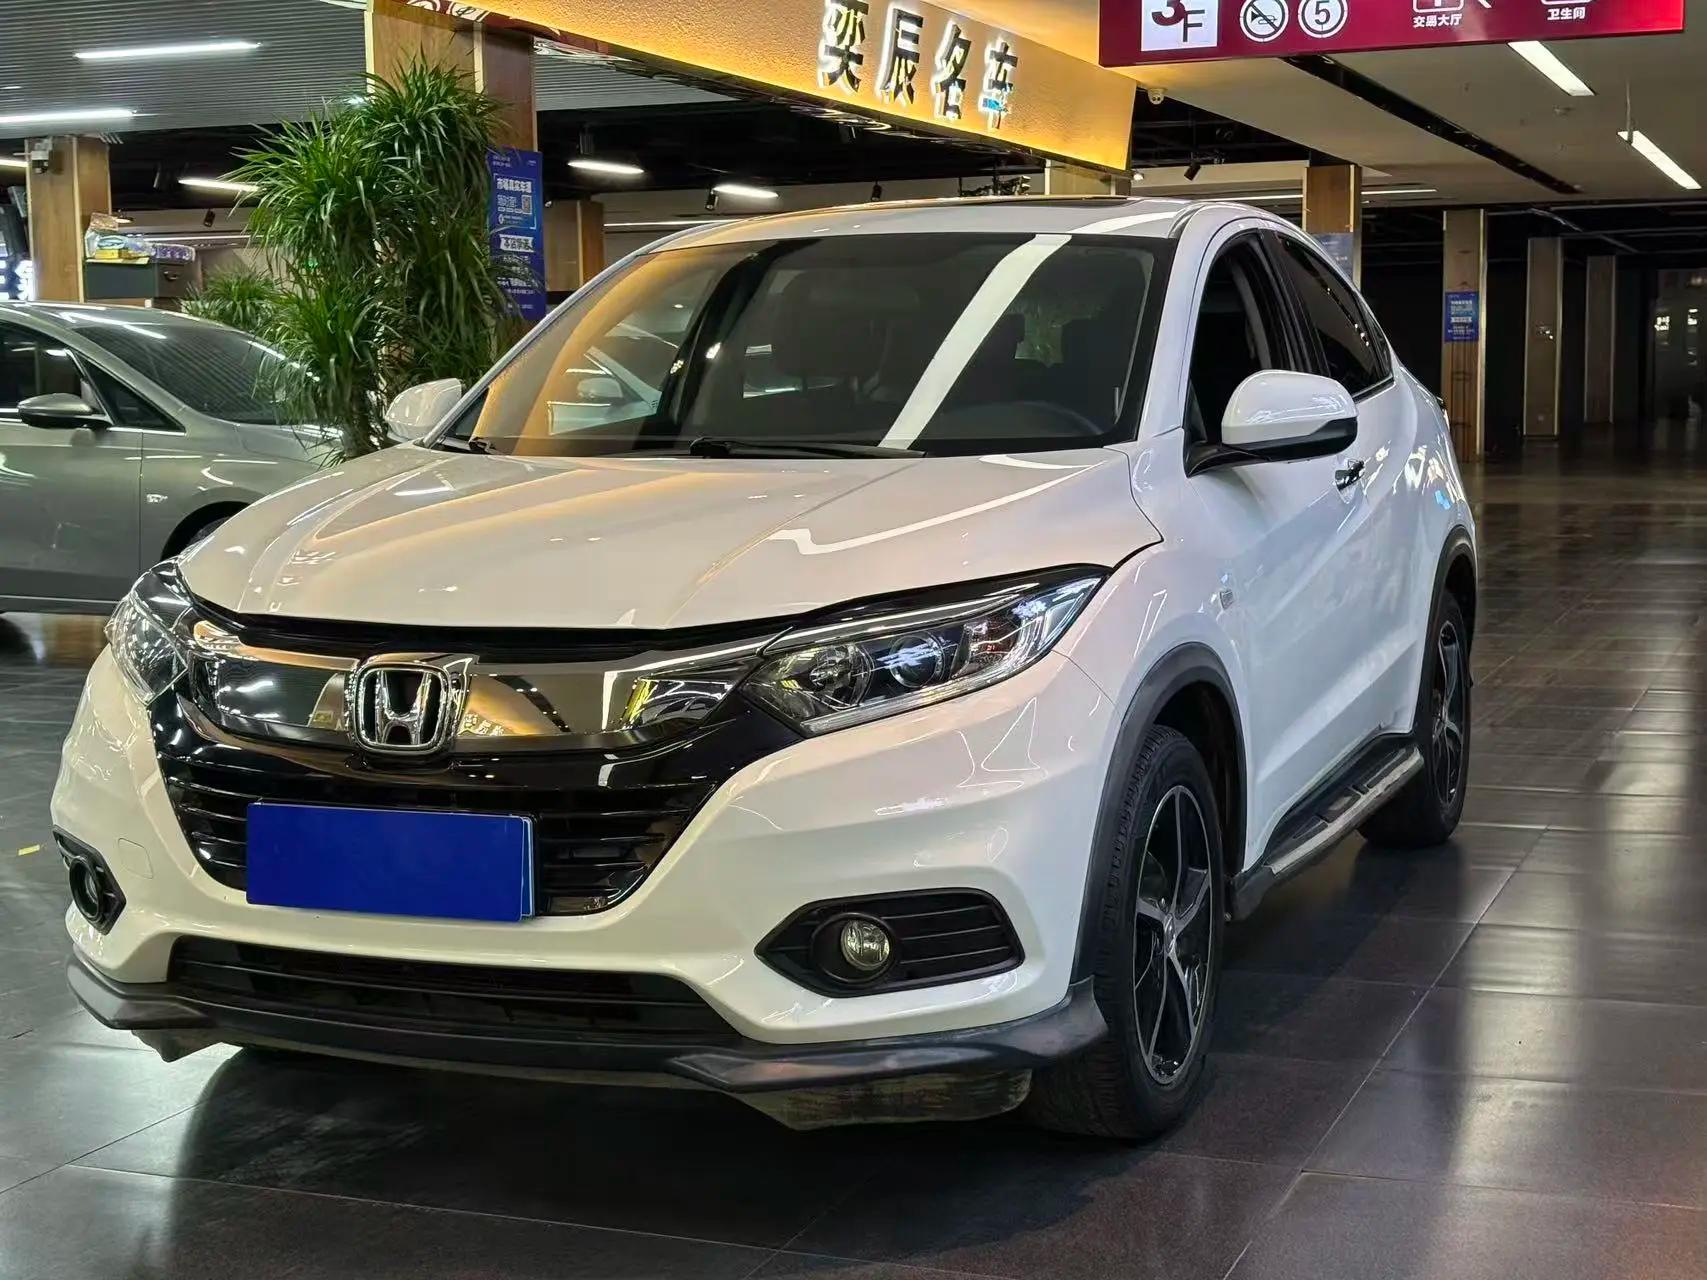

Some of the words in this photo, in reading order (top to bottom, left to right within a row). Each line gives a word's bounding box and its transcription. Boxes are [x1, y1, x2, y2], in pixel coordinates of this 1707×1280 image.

[1314, 0, 1331, 25] 5
[1547, 7, 1586, 21] 卫生间
[1413, 14, 1462, 28] 交易大厅
